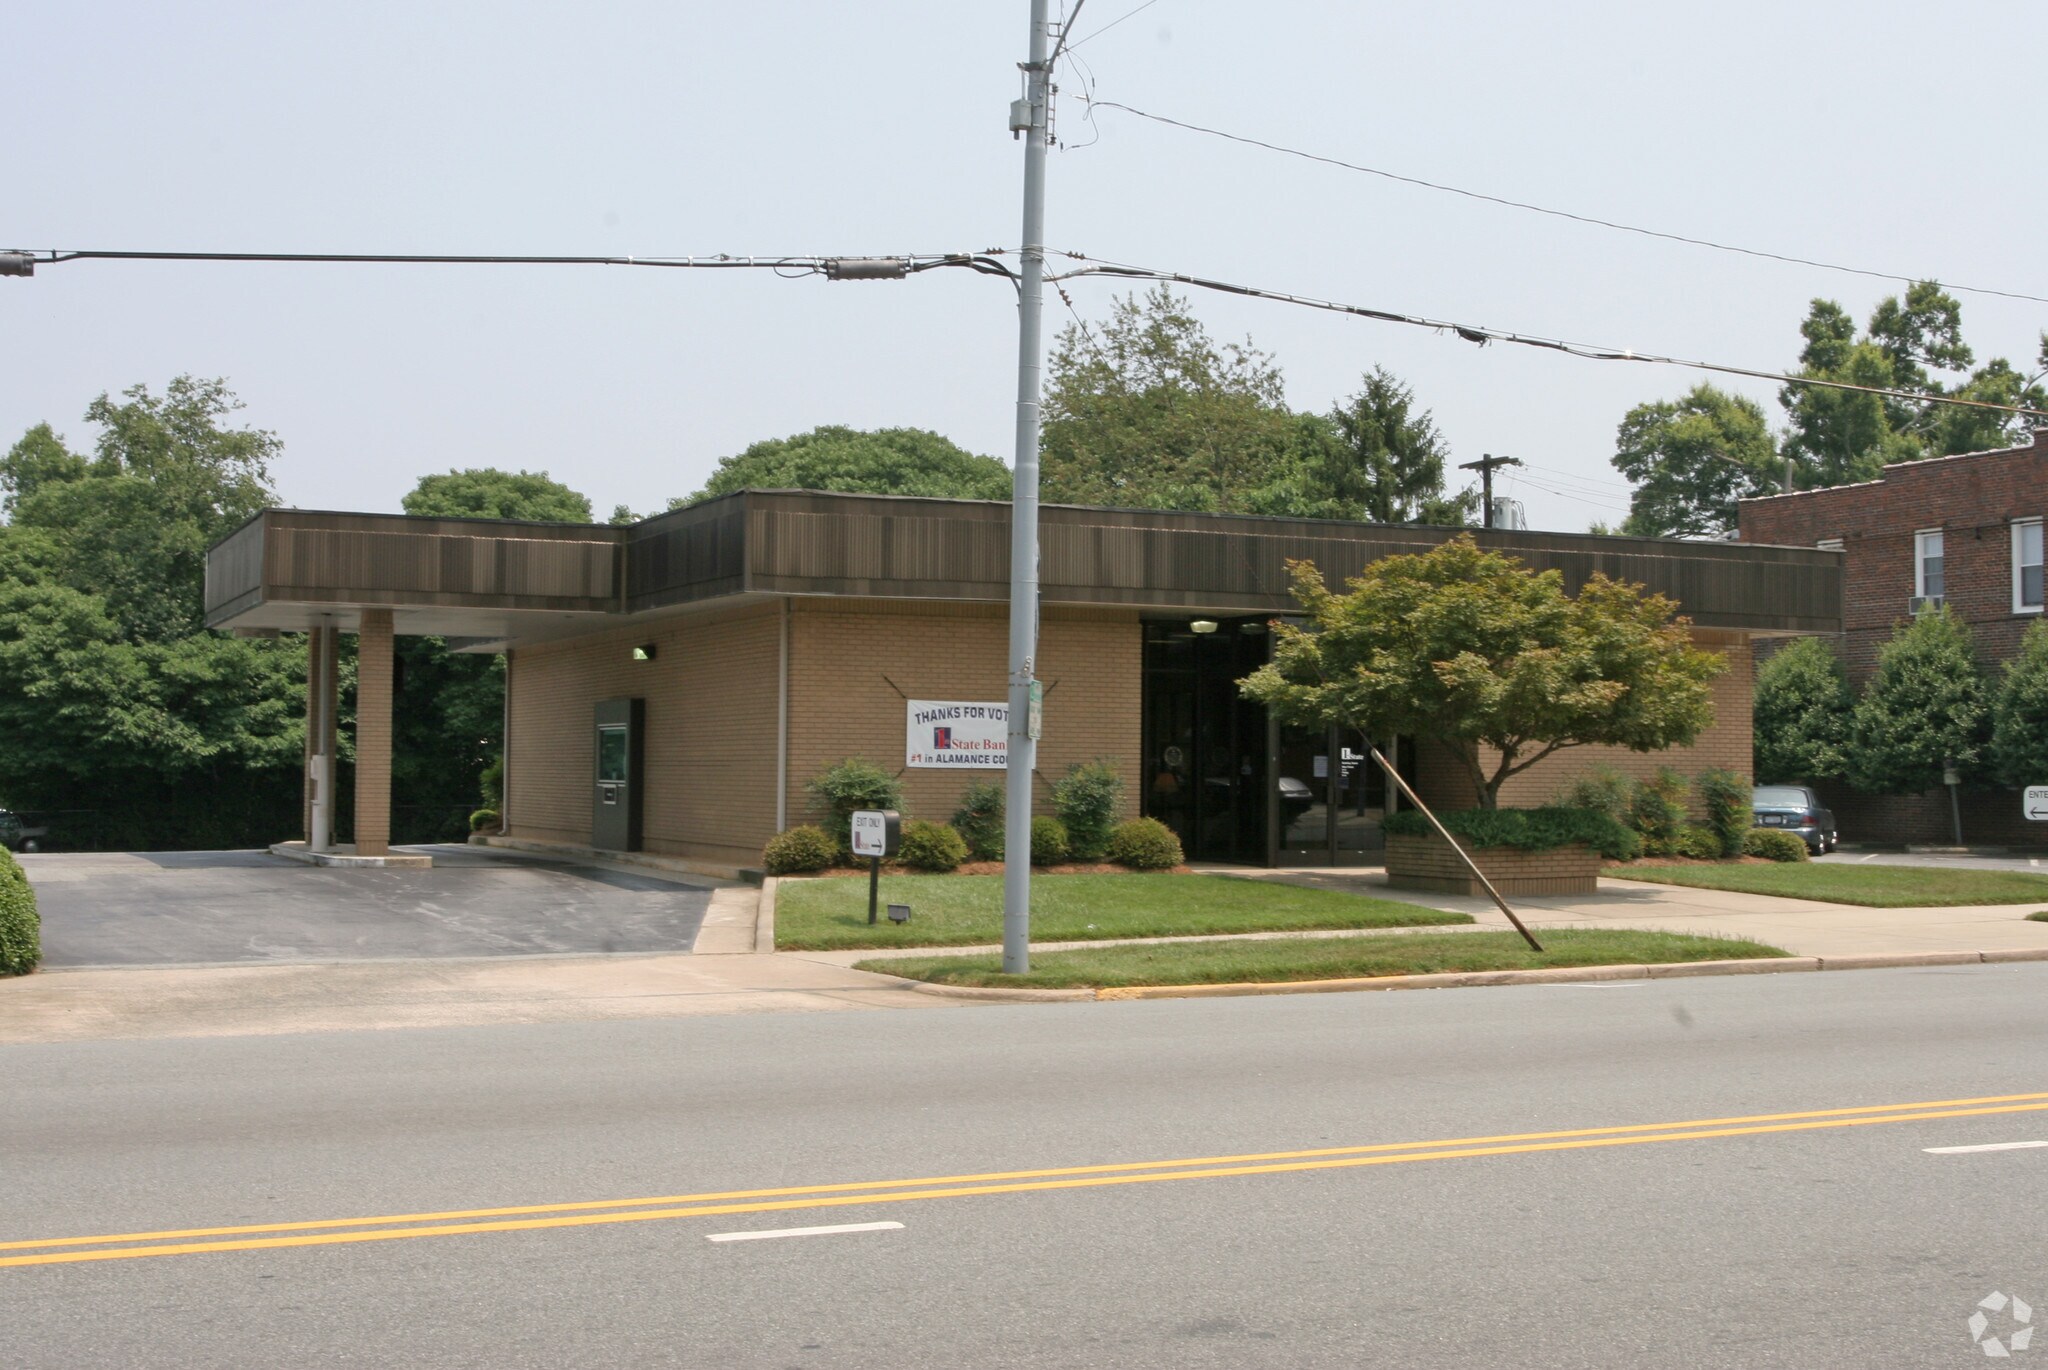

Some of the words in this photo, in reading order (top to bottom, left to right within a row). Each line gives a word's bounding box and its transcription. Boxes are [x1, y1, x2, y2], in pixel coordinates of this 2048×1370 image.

[915, 707, 960, 725] THANKS
[964, 707, 984, 718] FOR
[952, 739, 980, 750] State
[983, 739, 1008, 750] Ban
[911, 754, 922, 763] #1
[925, 754, 933, 763] in
[936, 754, 990, 764] ALAMANCE
